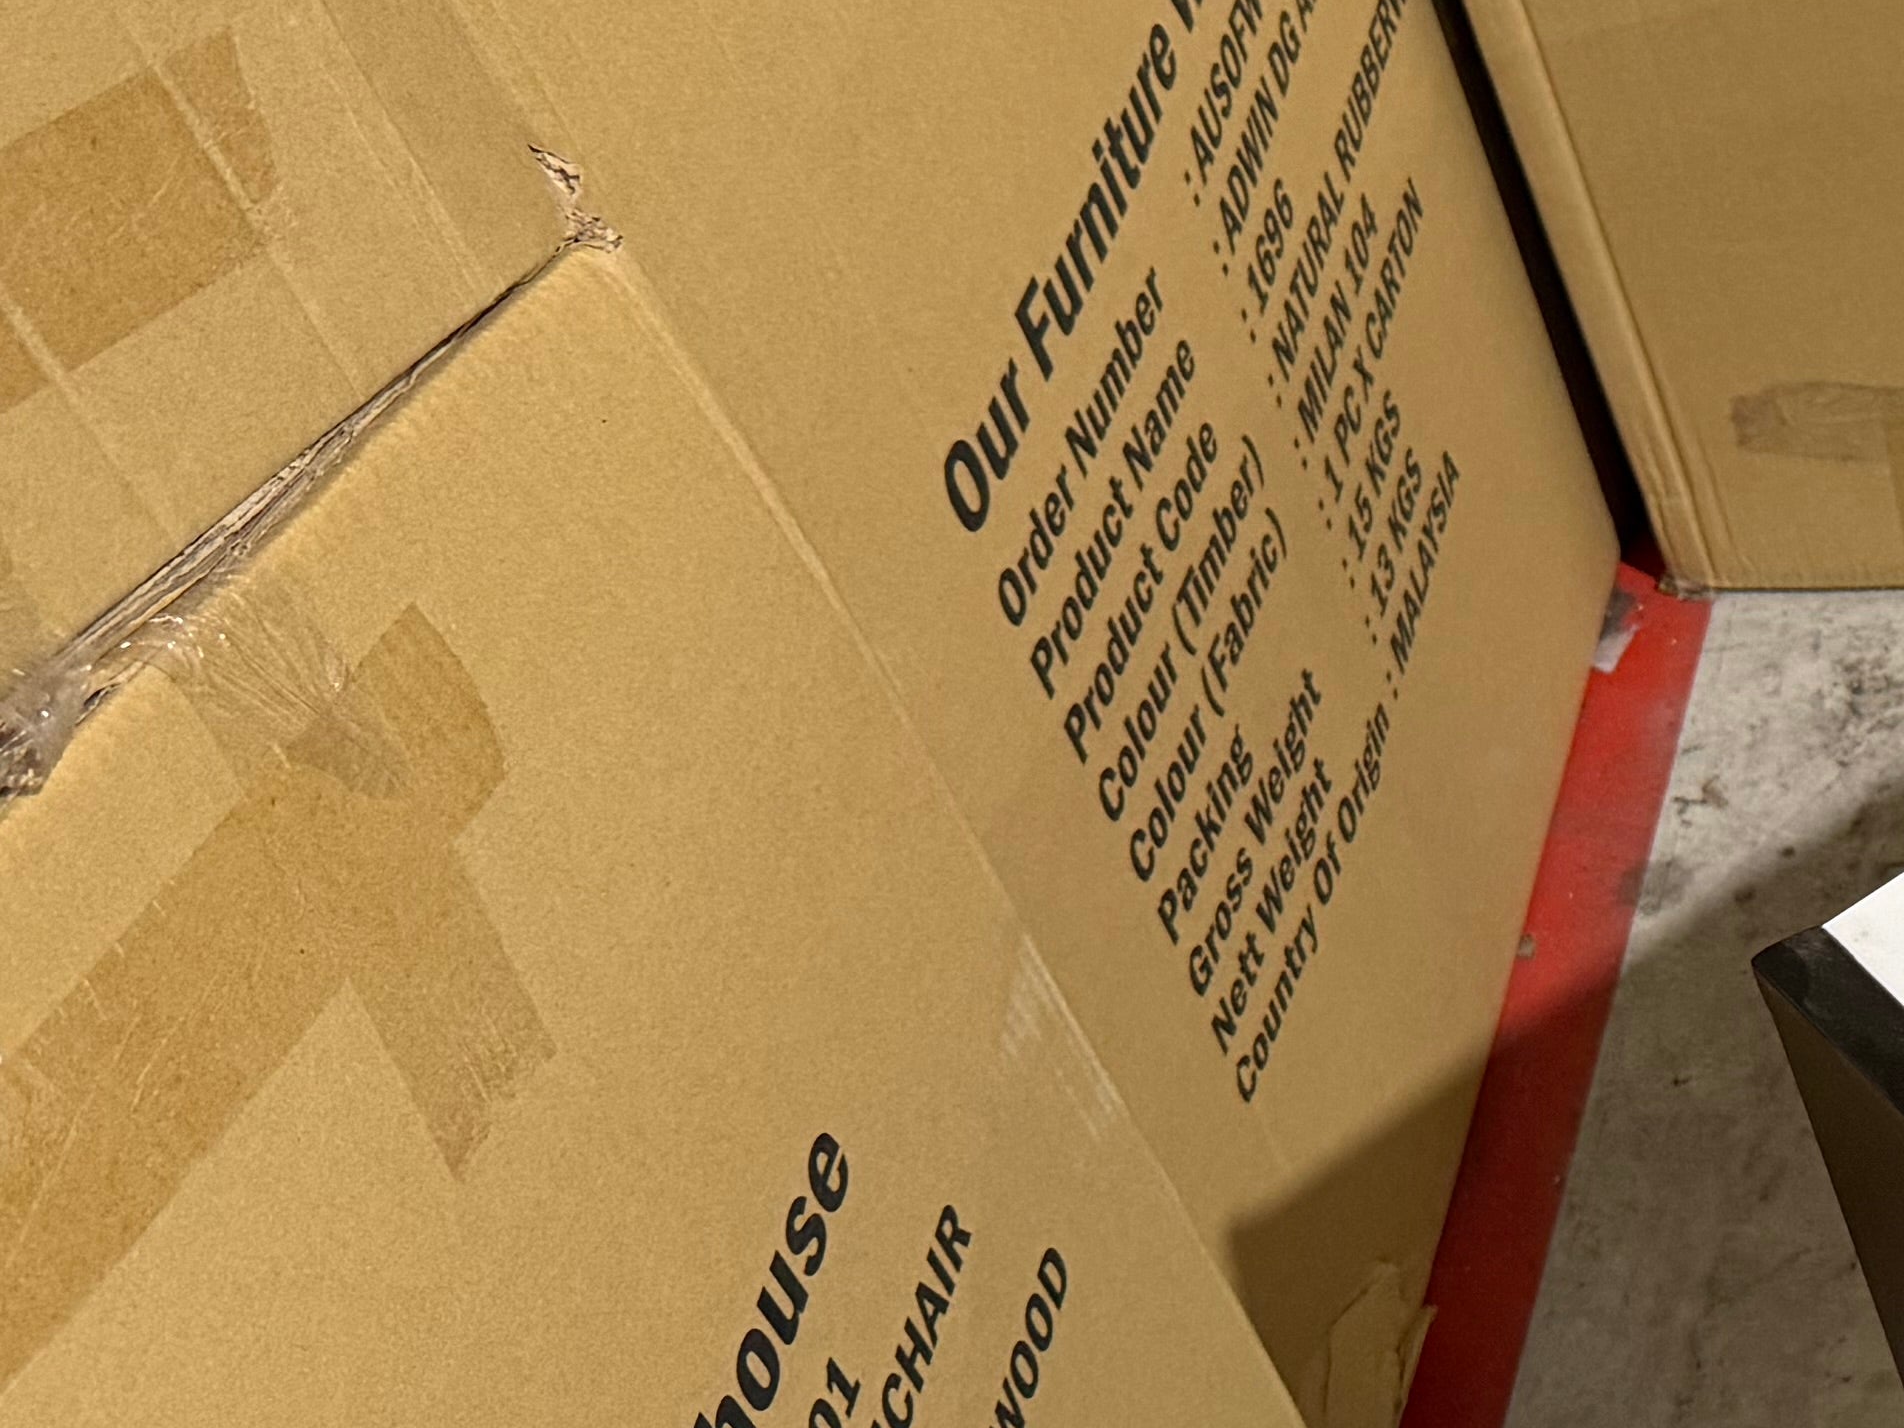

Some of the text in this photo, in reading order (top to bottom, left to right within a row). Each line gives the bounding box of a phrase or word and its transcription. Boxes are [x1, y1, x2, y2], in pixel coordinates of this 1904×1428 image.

[943, 357, 1031, 533] Our
[1013, 23, 1177, 382] Furniture
[997, 463, 1075, 627] Order
[1063, 266, 1163, 479] Number
[1029, 475, 1134, 701] Product
[1121, 339, 1196, 492] Name
[1219, 75, 1279, 256] ADWIN
[1266, 10, 1302, 98] DG
[1063, 542, 1164, 765] Product
[1155, 422, 1218, 552] Code
[1247, 177, 1294, 316] 1696
[1098, 641, 1178, 823] Colour
[1171, 434, 1265, 657] (Timber)
[1271, 171, 1345, 383] NATURAL
[1129, 703, 1207, 883] Colour
[1200, 507, 1287, 718] (Fabric)
[1297, 279, 1352, 445] MILAN
[1344, 193, 1378, 297] 104
[1323, 455, 1344, 504] 1
[1333, 384, 1362, 467] PC
[1352, 345, 1374, 403] X
[1364, 176, 1423, 360] CARTON
[1156, 723, 1254, 946] Packing
[1188, 846, 1253, 997] Gross
[1243, 668, 1322, 846] Weight
[1348, 482, 1373, 562] 15
[1364, 389, 1401, 498] KGS
[1210, 931, 1265, 1057] Nett
[1255, 757, 1332, 935] Weight
[1370, 543, 1395, 618] 13
[1387, 447, 1422, 554] KGS
[1235, 903, 1318, 1104] Country
[1312, 830, 1342, 906] Of
[1336, 702, 1390, 844] Origin
[1389, 450, 1460, 675] MALAYSIA
